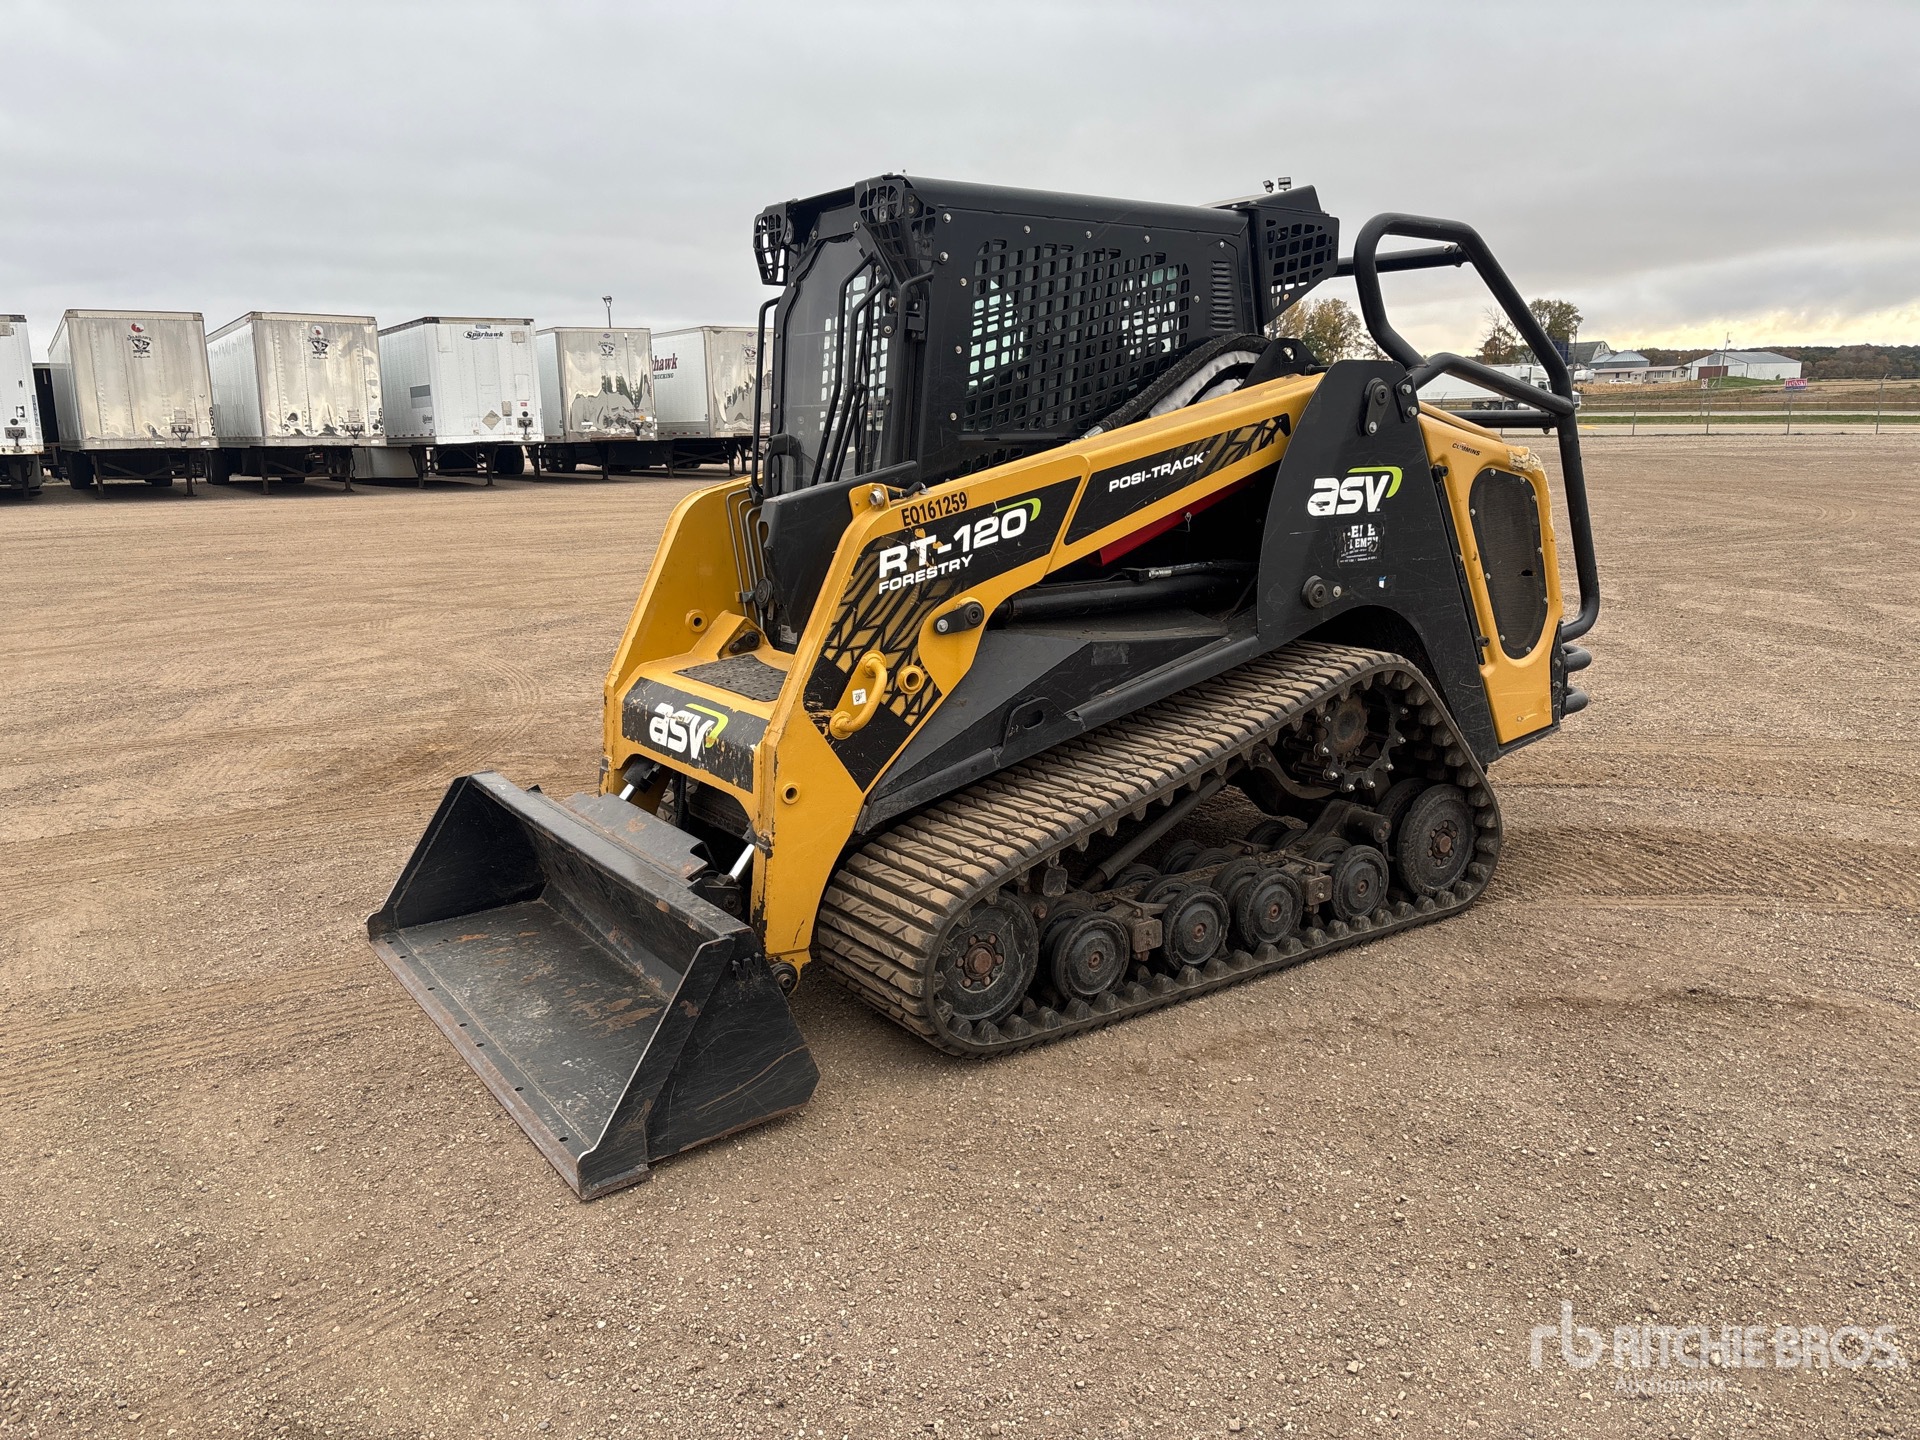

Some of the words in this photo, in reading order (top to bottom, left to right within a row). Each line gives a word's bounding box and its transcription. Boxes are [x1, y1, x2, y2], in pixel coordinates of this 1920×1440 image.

[1108, 451, 1205, 493] POSI-TRACK
[901, 490, 969, 528] EQ161259
[878, 507, 1028, 579] RT-120
[878, 553, 974, 595] FORESTRY
